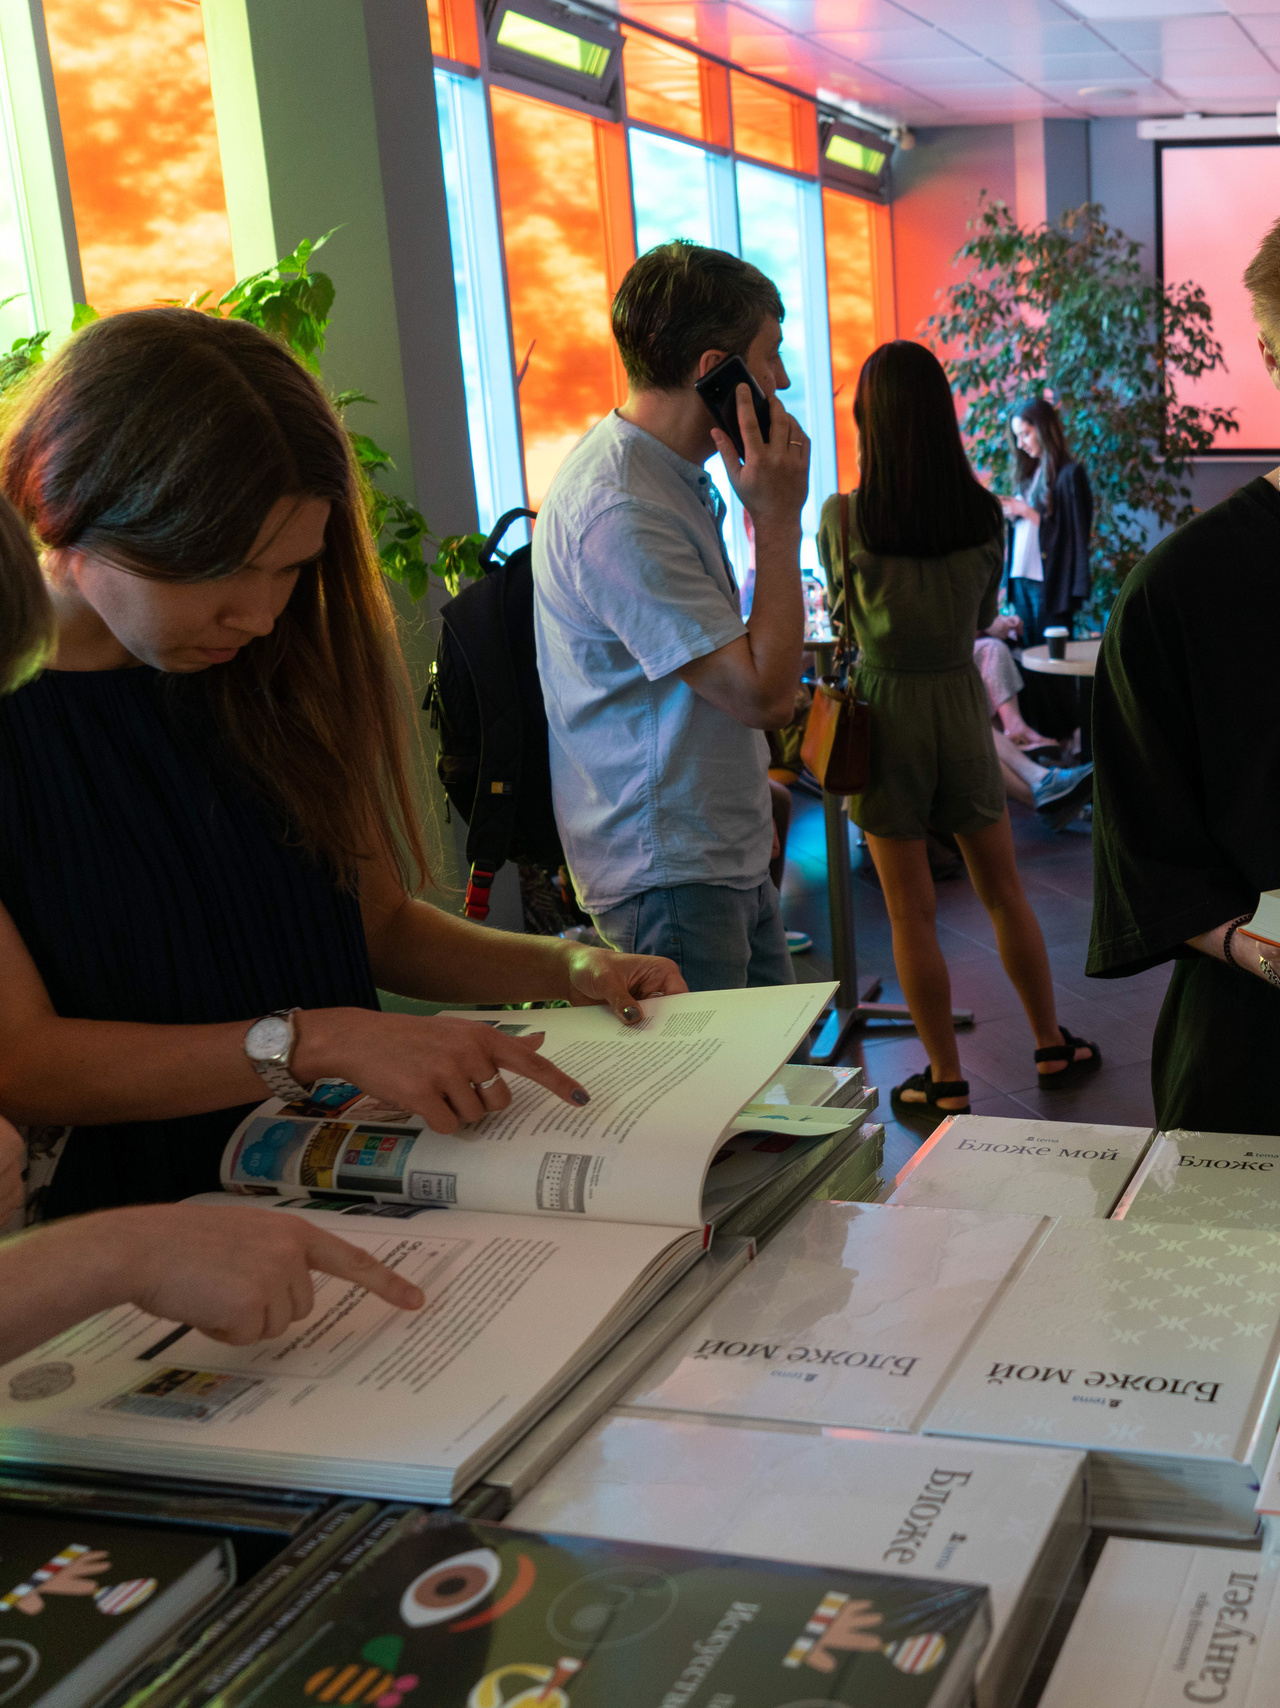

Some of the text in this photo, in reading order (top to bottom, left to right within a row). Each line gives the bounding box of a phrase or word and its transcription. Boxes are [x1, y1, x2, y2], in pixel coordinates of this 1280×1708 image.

[955, 1138, 1119, 1162] Бложе мой
[1177, 1154, 1275, 1173] Бложе
[694, 1339, 922, 1378] Бложе мой
[986, 1361, 1224, 1403] Бложе мой
[882, 1466, 973, 1566] Бложе
[1183, 1569, 1259, 1705] Санузел
